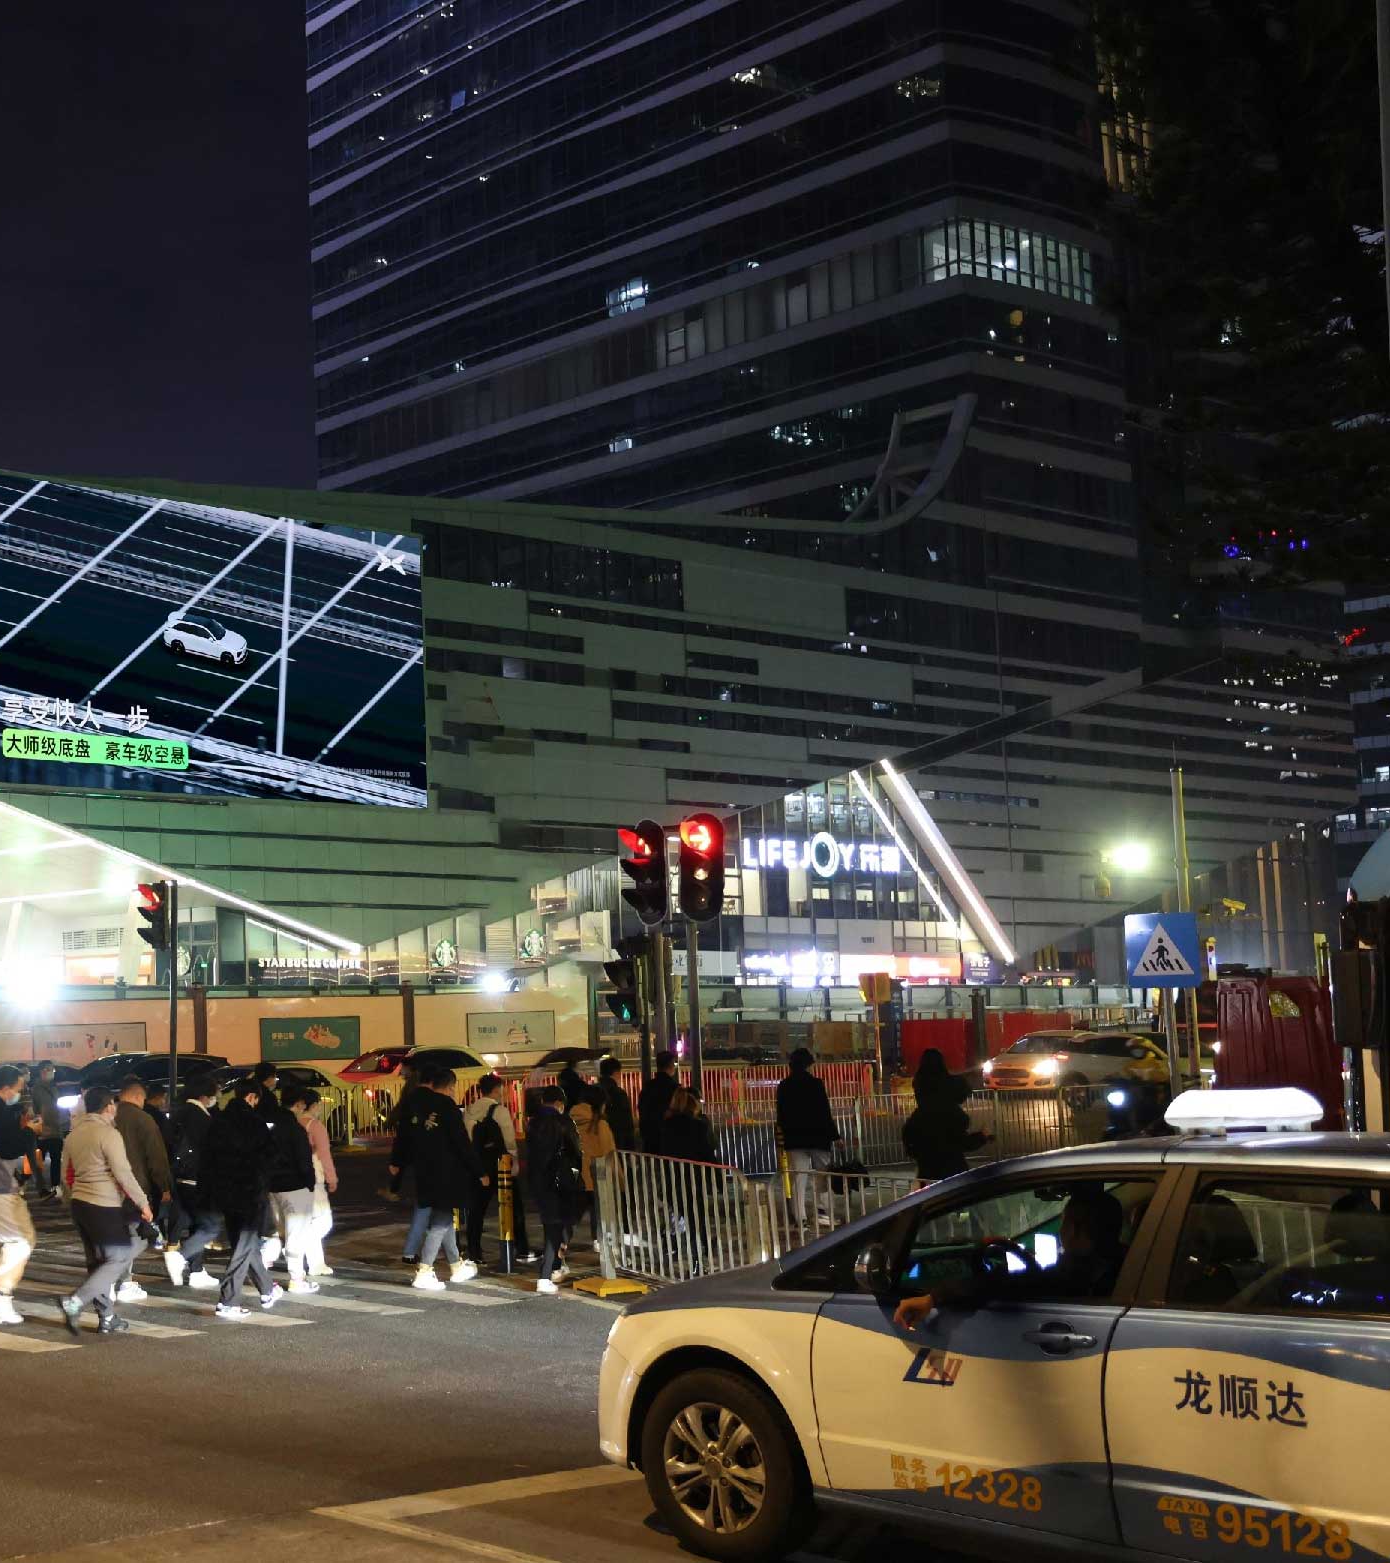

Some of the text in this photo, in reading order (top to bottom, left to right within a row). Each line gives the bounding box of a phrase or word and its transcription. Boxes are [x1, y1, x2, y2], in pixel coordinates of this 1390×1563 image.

[1, 697, 150, 734] 享受快人一步
[6, 733, 186, 766] 大师级底盘 豪车级空悬
[258, 957, 361, 970] STARBUCKS COFFEE
[1173, 1368, 1308, 1429] 龙顺达
[890, 1454, 926, 1475] 服务
[893, 1470, 930, 1494] 监督
[935, 1461, 1043, 1513] 12328
[1163, 1497, 1204, 1515] TAXI
[1163, 1502, 1354, 1561] 电召 95128
